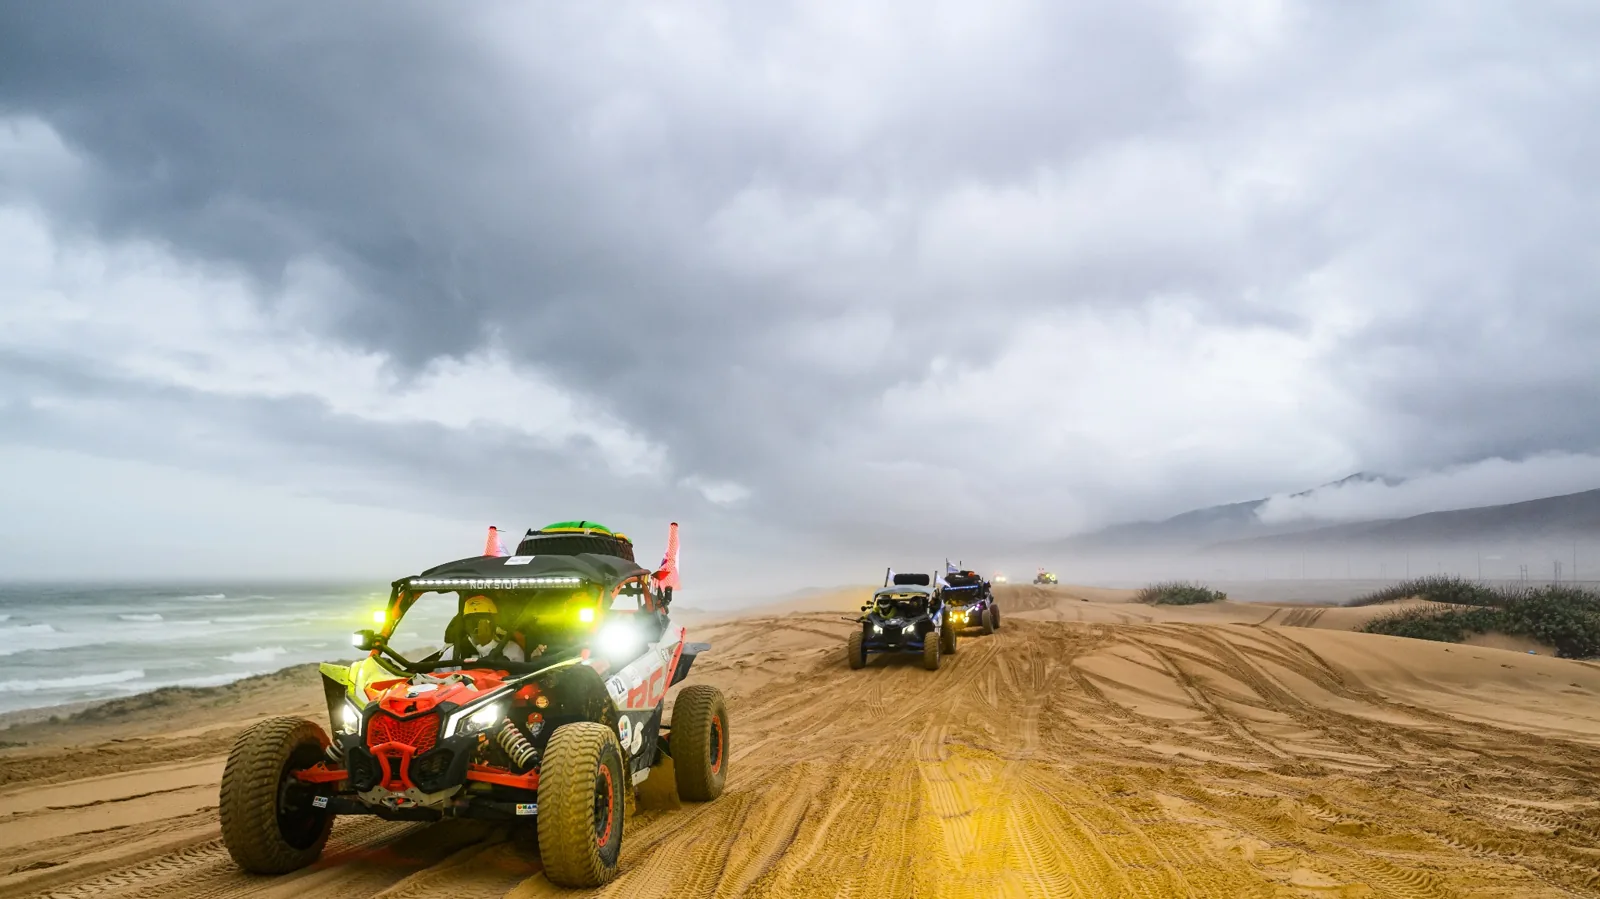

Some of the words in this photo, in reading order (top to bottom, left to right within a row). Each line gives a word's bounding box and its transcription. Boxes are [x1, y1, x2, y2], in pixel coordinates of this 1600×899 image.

[470, 581, 490, 590] NON
[494, 581, 518, 590] STOP
[611, 678, 625, 695] 22
